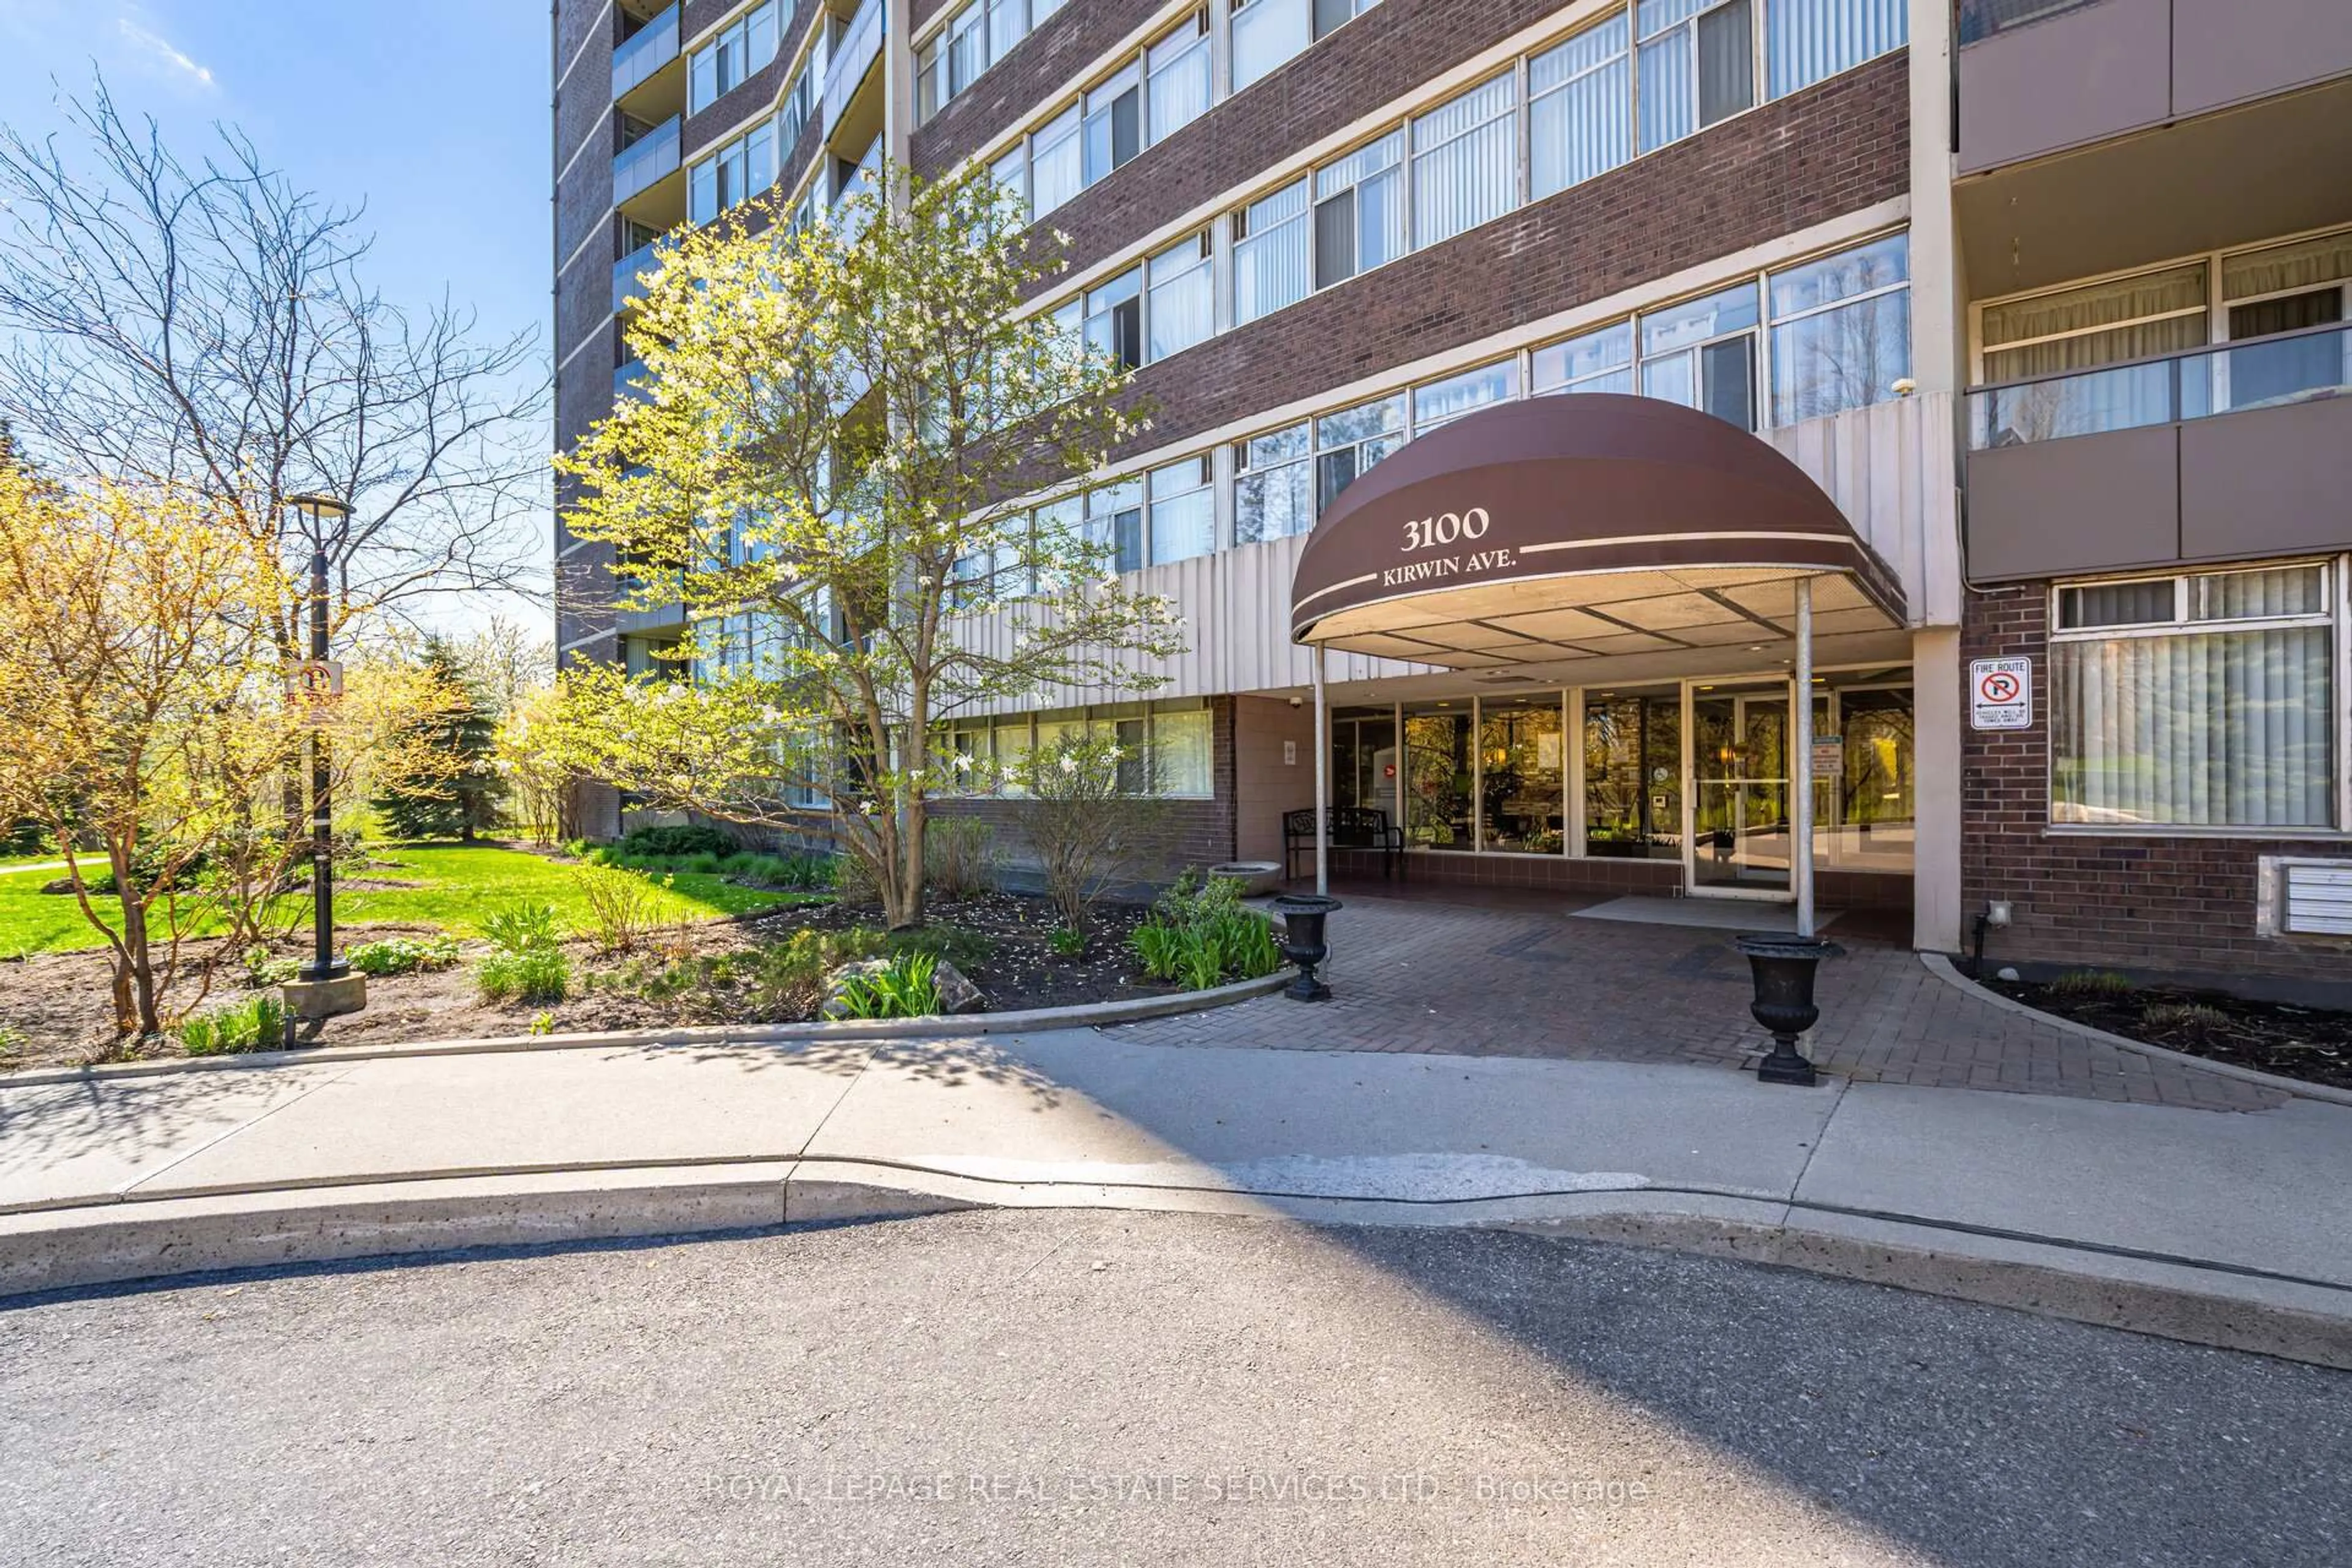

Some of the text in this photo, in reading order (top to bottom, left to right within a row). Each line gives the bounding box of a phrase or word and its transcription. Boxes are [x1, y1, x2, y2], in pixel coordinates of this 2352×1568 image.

[1401, 508, 1490, 551] 3100
[1383, 549, 1517, 586] KIRWIN AVE.
[1976, 662, 2025, 673] FIRE ROUTE
